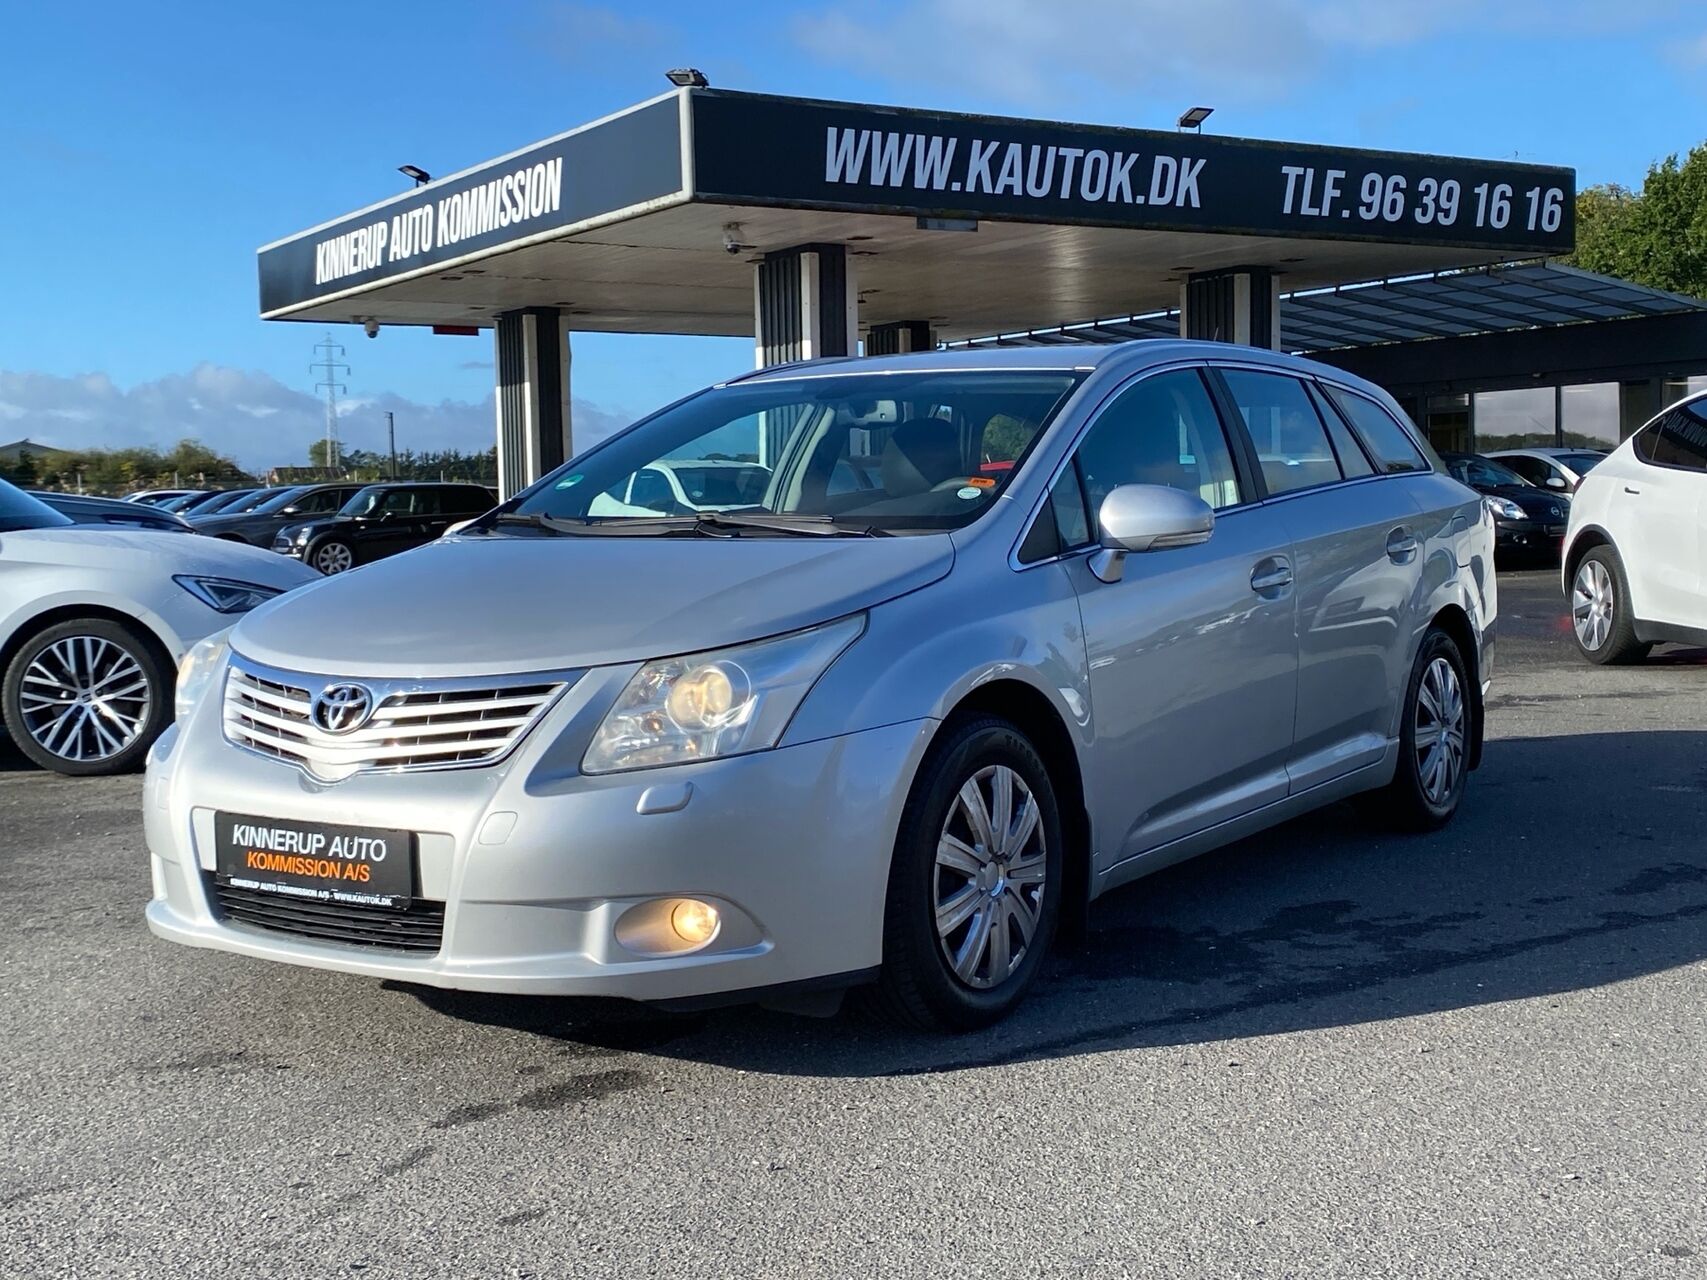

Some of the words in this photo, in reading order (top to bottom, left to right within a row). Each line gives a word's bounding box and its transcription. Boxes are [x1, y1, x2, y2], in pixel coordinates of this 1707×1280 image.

[825, 126, 1207, 208] WWW.KAUTOK.DK
[316, 221, 388, 286] KINNERUP
[388, 204, 434, 263] AUTO
[437, 157, 563, 248] KOMMISSION
[1281, 165, 1350, 218] TLF.
[1358, 172, 1407, 222] 96
[1414, 177, 1461, 226] 39
[1474, 182, 1512, 229] 16
[1525, 186, 1564, 233] 16
[232, 823, 326, 855] KINNERUP
[328, 836, 388, 863] AUTO
[247, 851, 341, 879] KOMMISSION
[343, 862, 371, 883] A/S
[260, 882, 277, 893] AUTO
[333, 892, 393, 907] WWW.KAUTOK.DK
